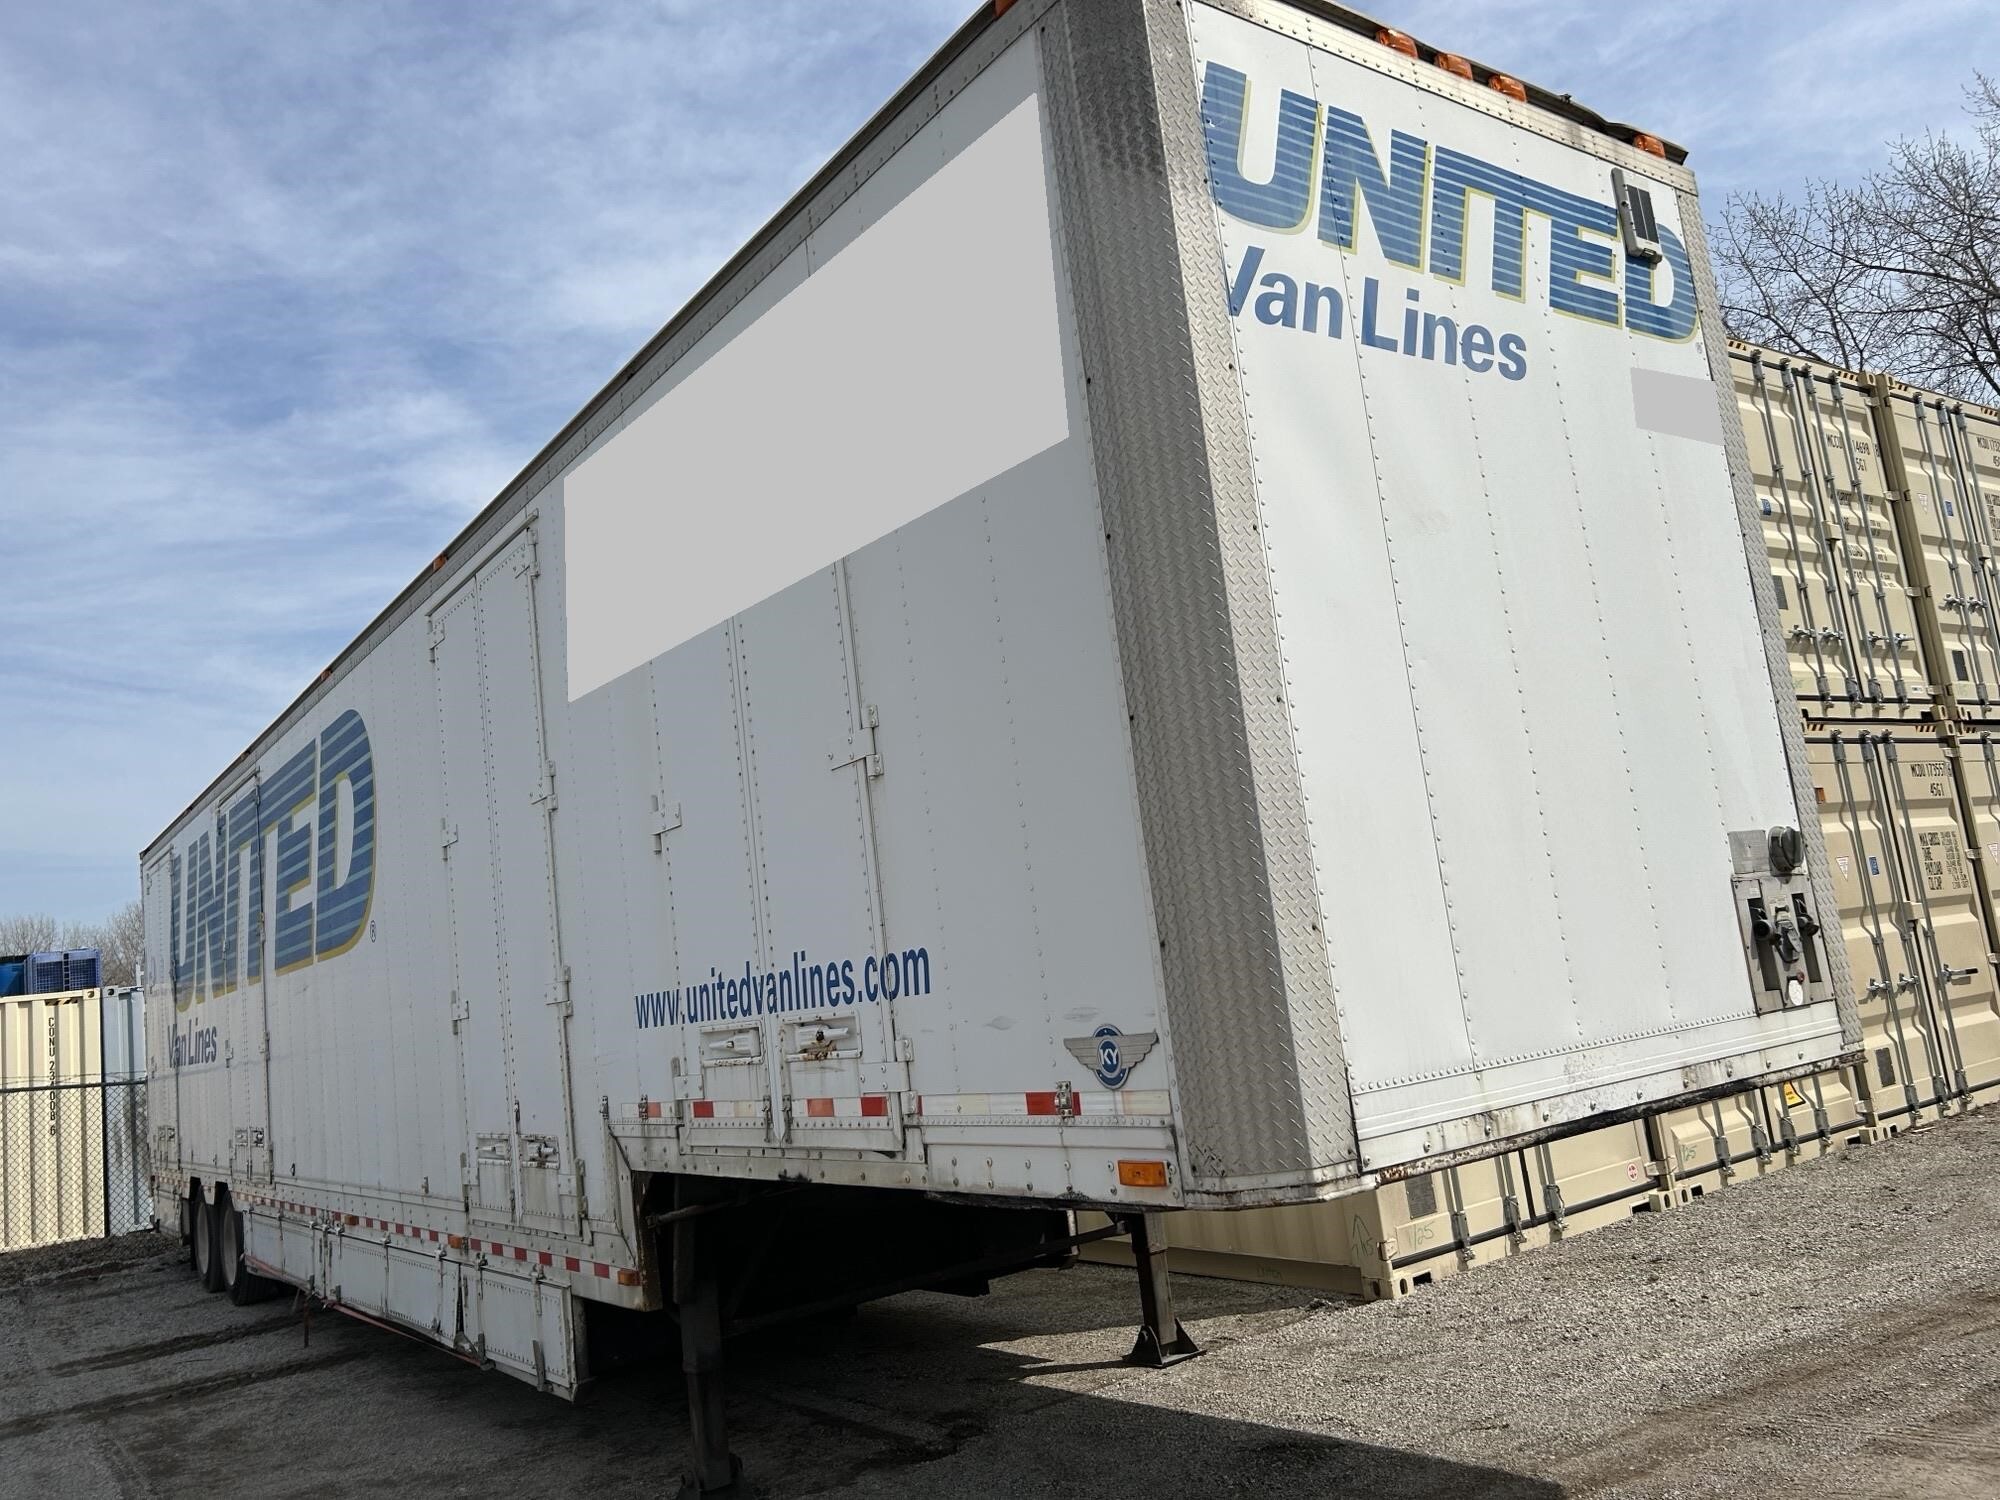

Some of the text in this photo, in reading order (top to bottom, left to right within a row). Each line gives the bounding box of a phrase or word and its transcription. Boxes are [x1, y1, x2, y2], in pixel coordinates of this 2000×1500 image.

[1201, 60, 1699, 345] UNITED
[1228, 245, 1527, 381] Van Lines
[171, 708, 377, 1013] UNITED
[167, 1016, 217, 1069] Van Lines
[634, 946, 931, 1030] www.unitedvanlines.com
[1100, 1047, 1119, 1065] KY
